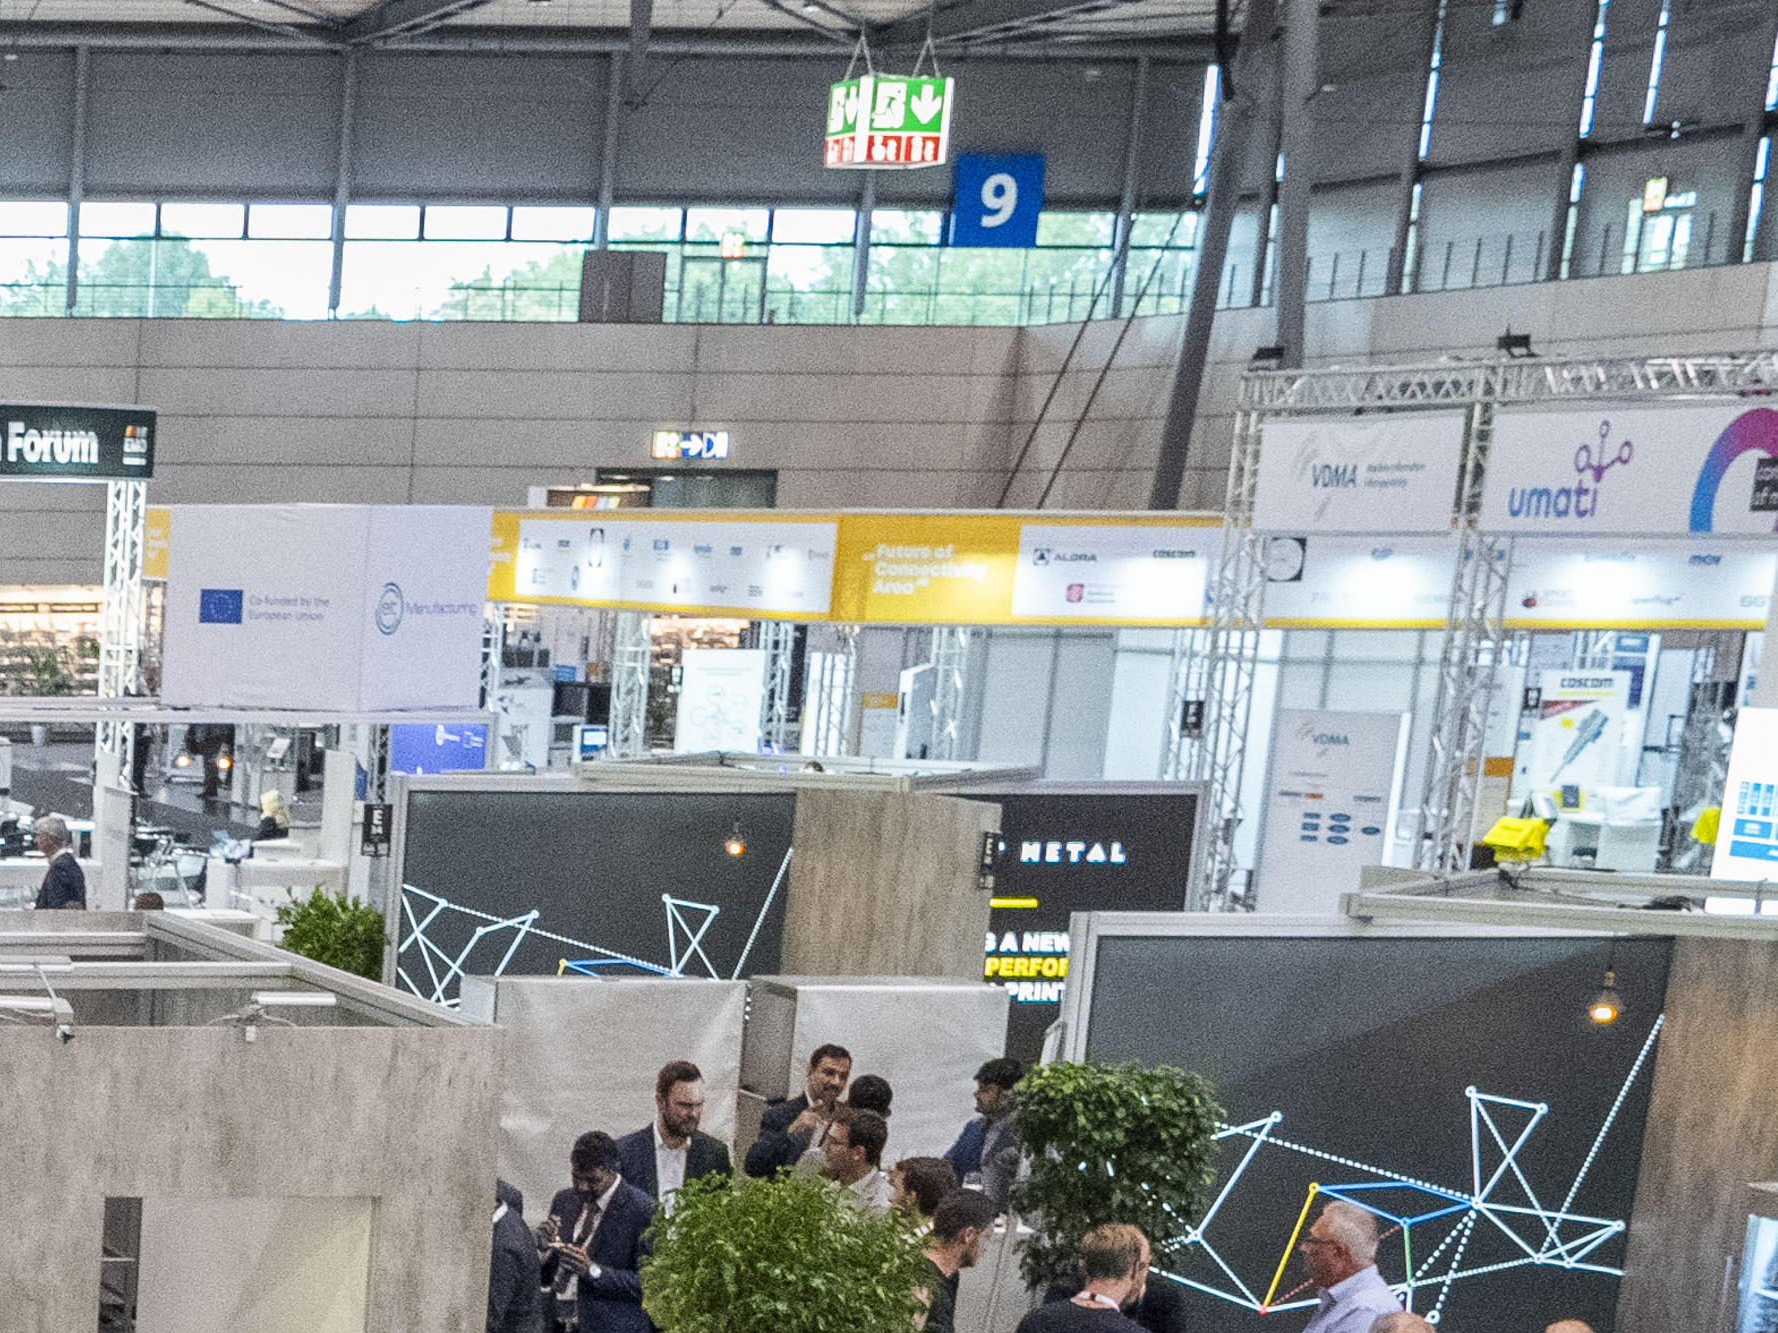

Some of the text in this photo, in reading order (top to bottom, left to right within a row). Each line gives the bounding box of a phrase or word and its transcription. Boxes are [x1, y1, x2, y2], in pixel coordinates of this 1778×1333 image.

[979, 172, 1018, 227] 9
[7, 422, 98, 464] Forum
[1313, 464, 1357, 487] VDMA
[1509, 482, 1599, 519] umati
[877, 545, 954, 559] Future of
[874, 562, 988, 581] Connectivity
[874, 580, 916, 594] Area
[1020, 841, 1127, 864] METAL
[1000, 932, 1020, 953] A
